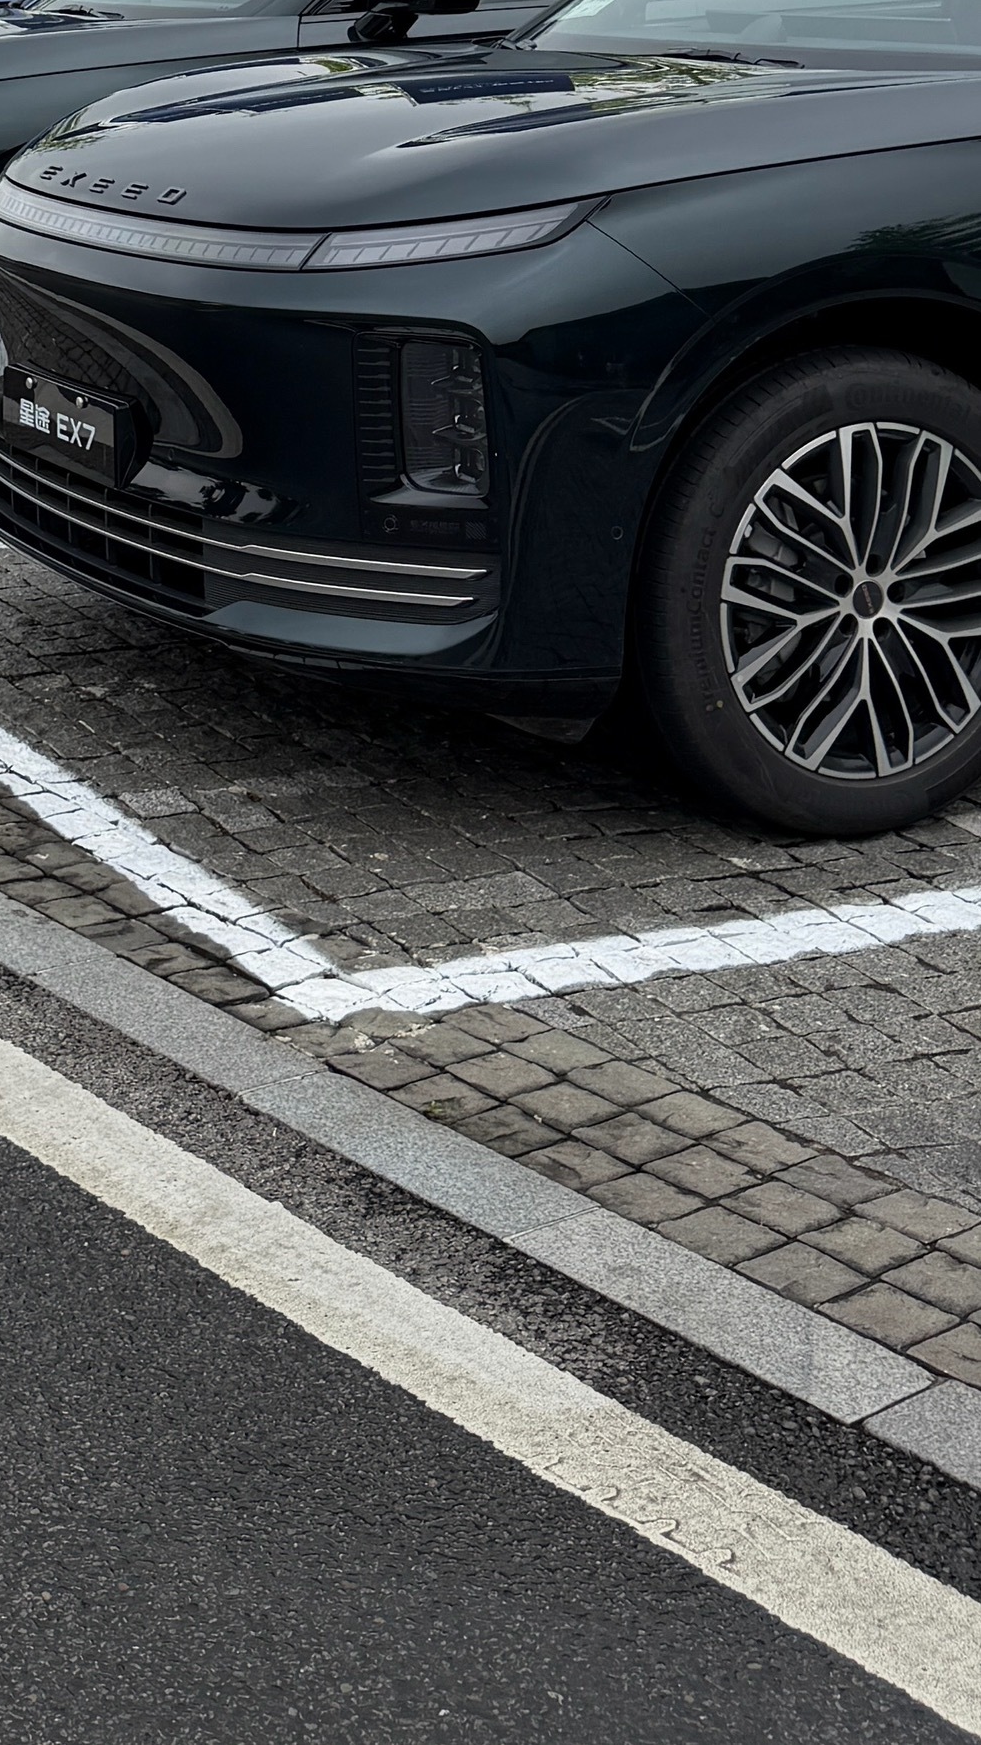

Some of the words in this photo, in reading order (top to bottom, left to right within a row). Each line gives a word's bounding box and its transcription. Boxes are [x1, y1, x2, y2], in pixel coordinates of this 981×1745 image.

[39, 165, 187, 205] EXEED
[19, 397, 51, 435] 星途
[56, 412, 96, 451] EX7
